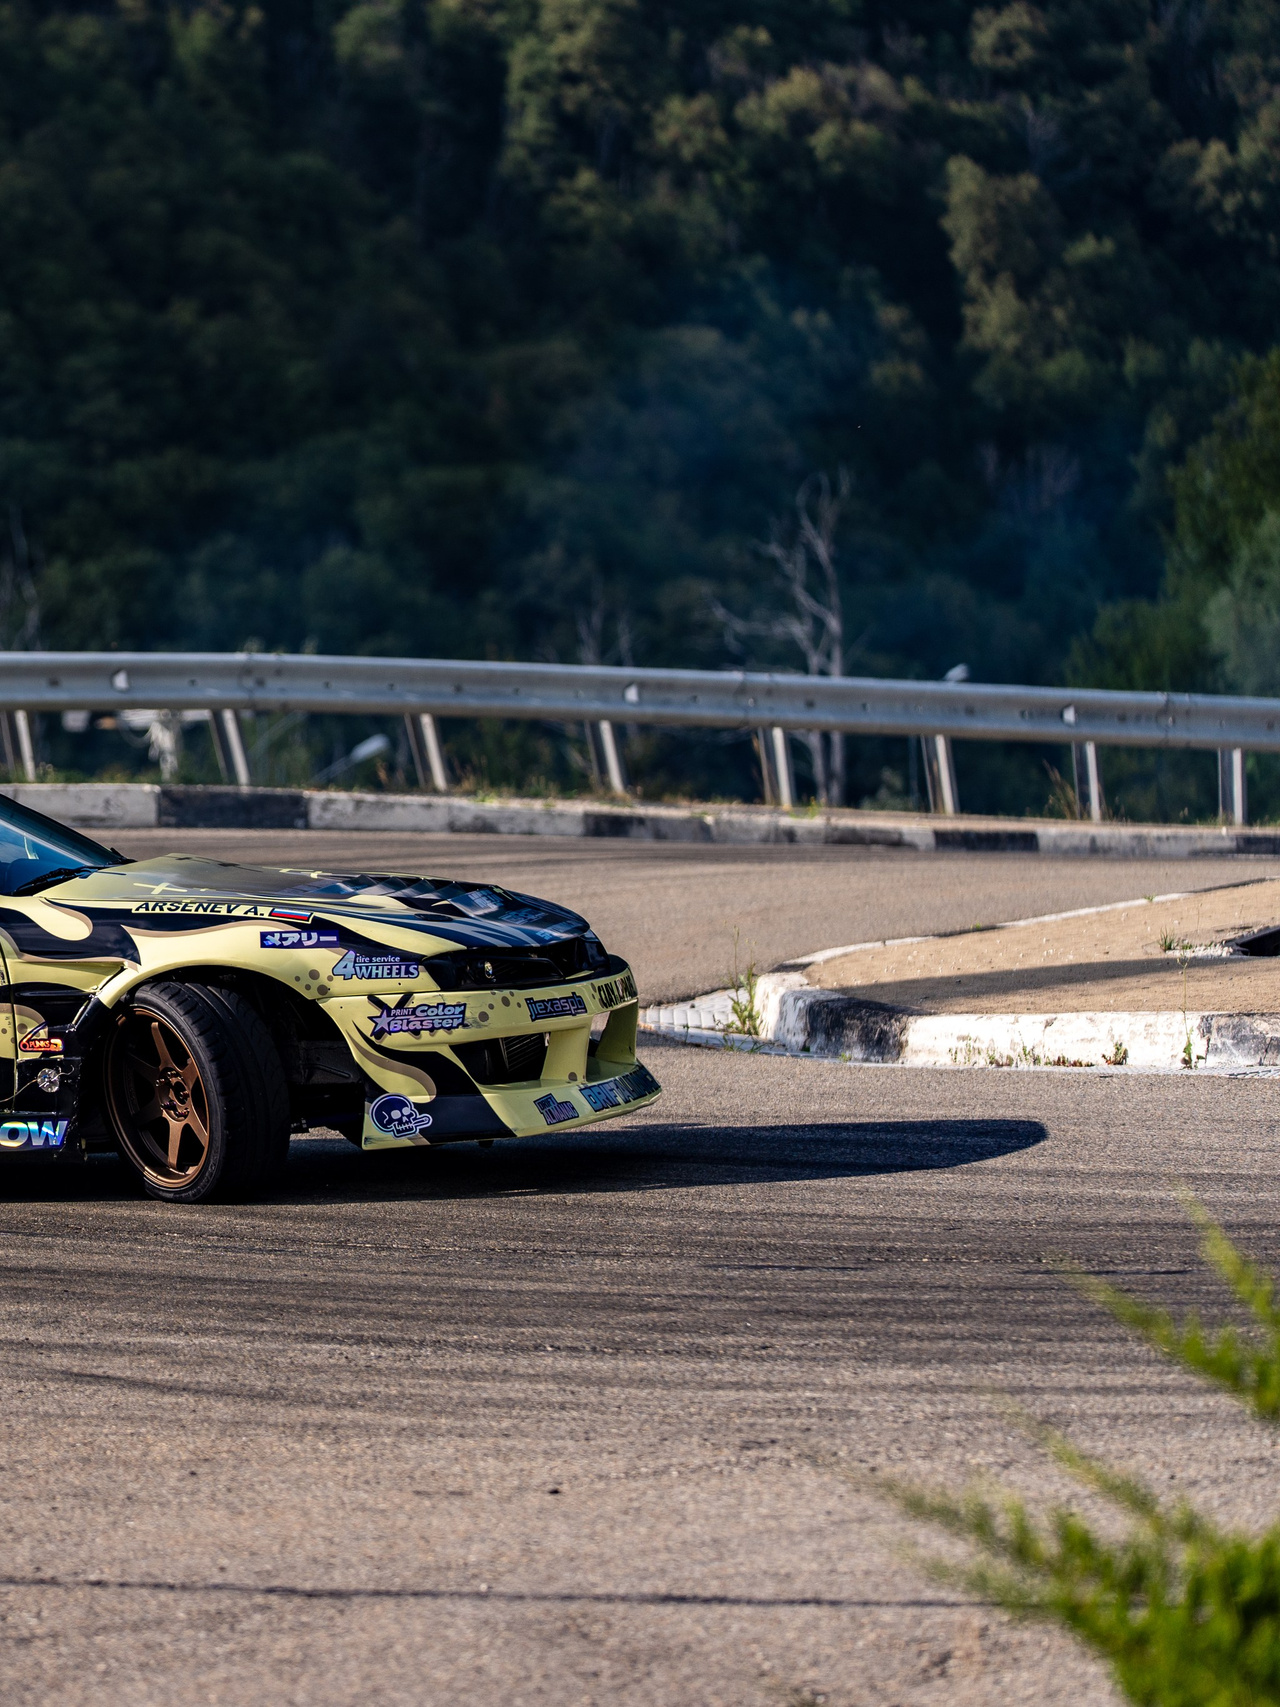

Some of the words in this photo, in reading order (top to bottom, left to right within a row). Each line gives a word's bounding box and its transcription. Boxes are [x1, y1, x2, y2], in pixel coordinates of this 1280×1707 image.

[134, 902, 240, 914] ARSENEV
[243, 905, 265, 916] A.
[263, 932, 338, 947] メアリー
[356, 954, 370, 963] tire
[371, 955, 401, 963] service
[355, 964, 419, 979] WHEELS
[390, 1008, 414, 1016] PRINT
[415, 1004, 465, 1016] Color
[527, 994, 586, 1019] jiexaspb
[389, 1017, 463, 1031] Blaster
